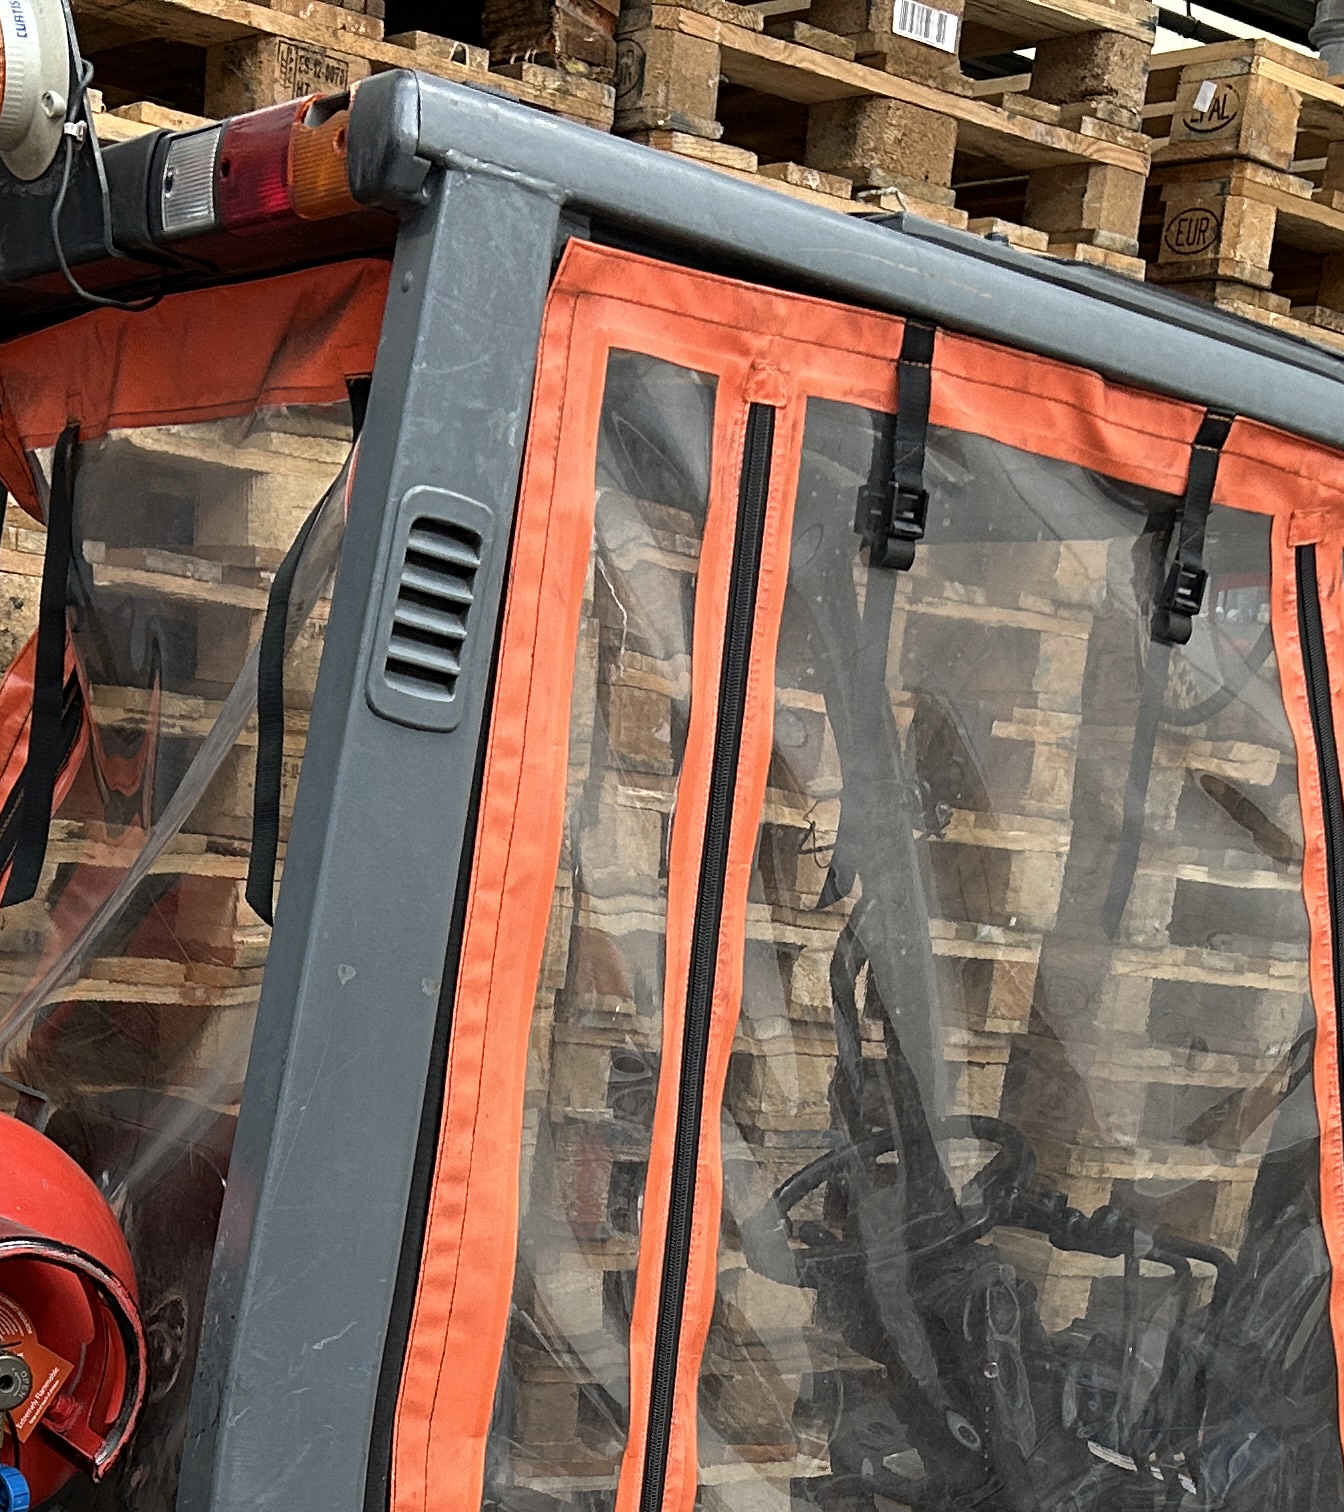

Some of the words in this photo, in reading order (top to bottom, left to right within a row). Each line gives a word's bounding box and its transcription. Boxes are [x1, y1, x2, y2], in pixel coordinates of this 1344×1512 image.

[1189, 93, 1230, 123] AL
[1174, 216, 1211, 247] EUR
[18, 1370, 30, 1399] OPEN
